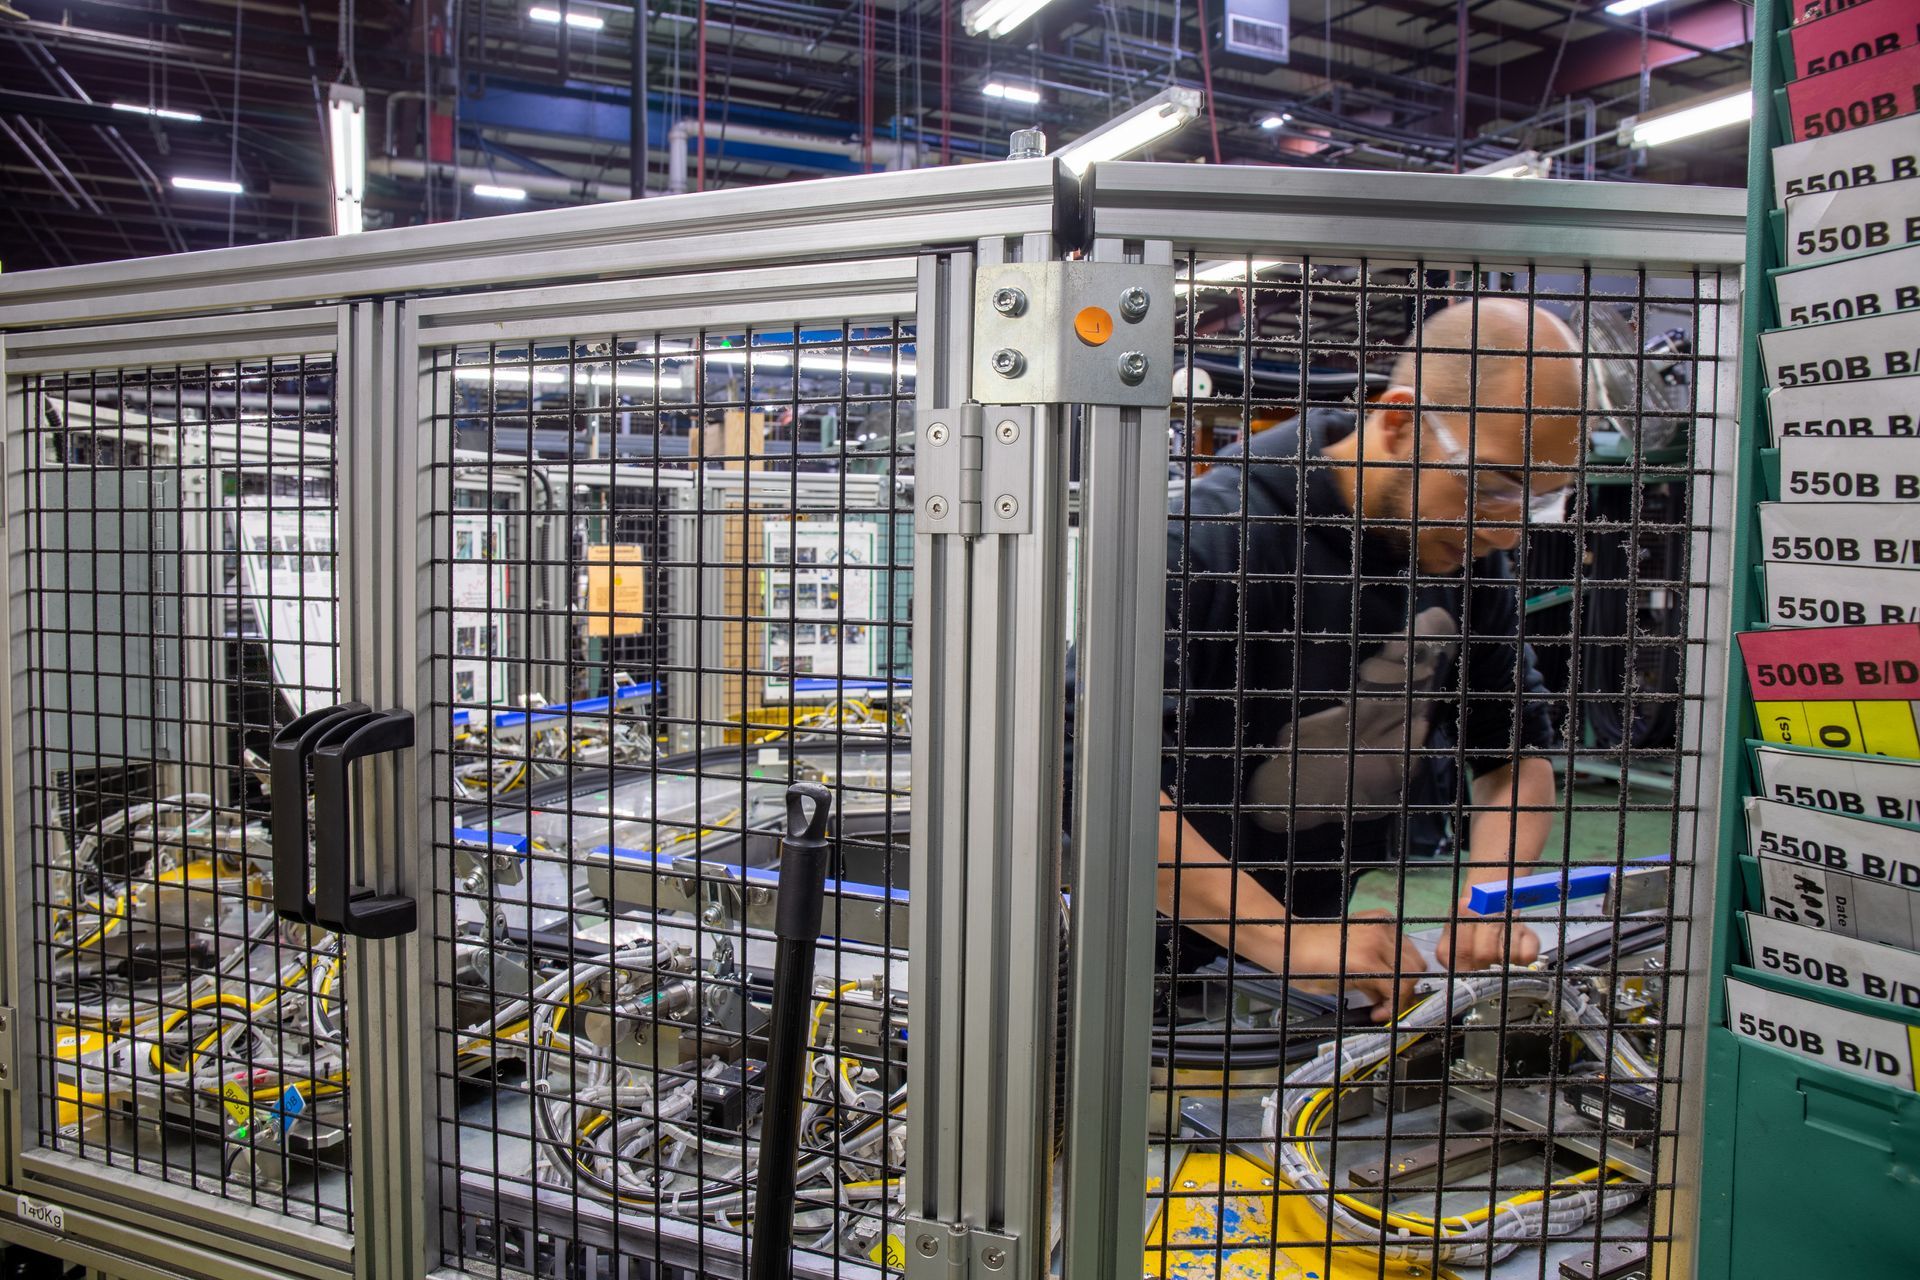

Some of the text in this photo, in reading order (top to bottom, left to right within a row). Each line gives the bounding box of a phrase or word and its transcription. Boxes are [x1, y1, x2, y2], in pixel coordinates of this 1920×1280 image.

[1804, 93, 1899, 139] 500B
[1786, 164, 1877, 195] 550B
[1797, 221, 1890, 256] 550B
[1790, 293, 1882, 327] 550B
[1778, 355, 1872, 387] 550B
[1783, 417, 1875, 437] 550B
[1790, 471, 1880, 498] 550B
[1772, 536, 1861, 561] 550B
[1777, 596, 1867, 625] 550B
[1757, 660, 1919, 687] 500B B/D
[1775, 716, 1792, 744] cs)
[1775, 784, 1920, 821] 550B B/
[1760, 830, 1920, 887] 550B B/D
[1835, 895, 1847, 927] Date
[1762, 946, 1920, 1008] 550B B/D
[1739, 1012, 1900, 1077] 550B B/D
